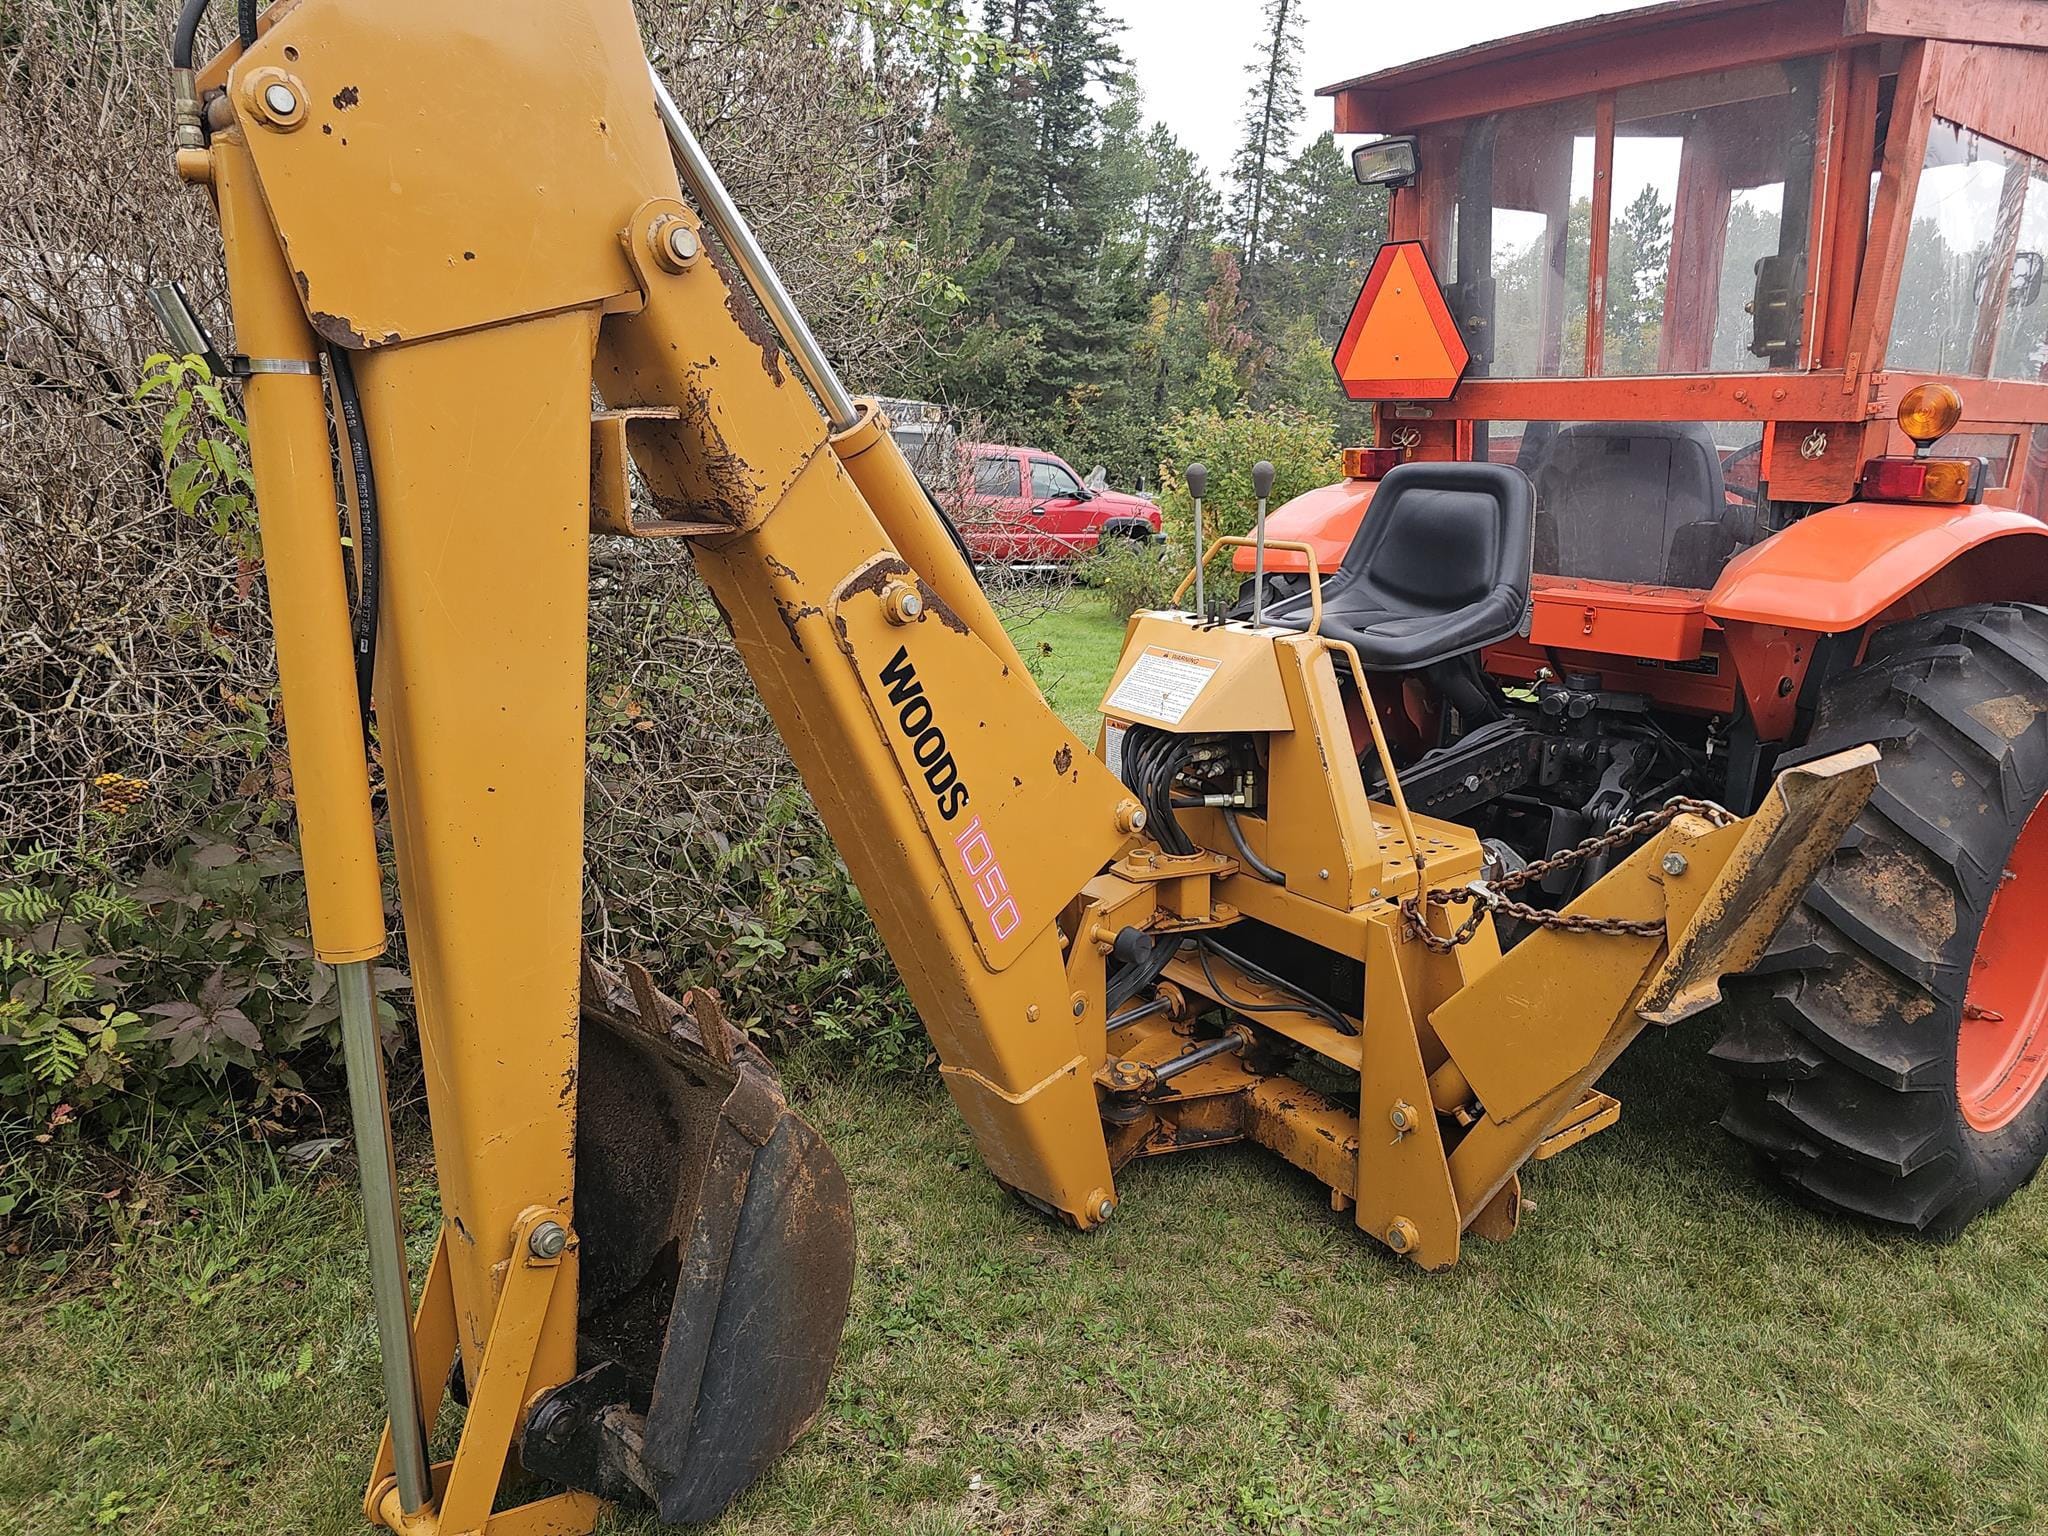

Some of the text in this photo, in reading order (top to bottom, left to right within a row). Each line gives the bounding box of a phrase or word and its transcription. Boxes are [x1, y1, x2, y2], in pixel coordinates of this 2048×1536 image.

[357, 474, 368, 498] SERIES
[1170, 654, 1200, 665] WARNING
[879, 645, 969, 821] WOODS
[955, 815, 1021, 942] 1050
